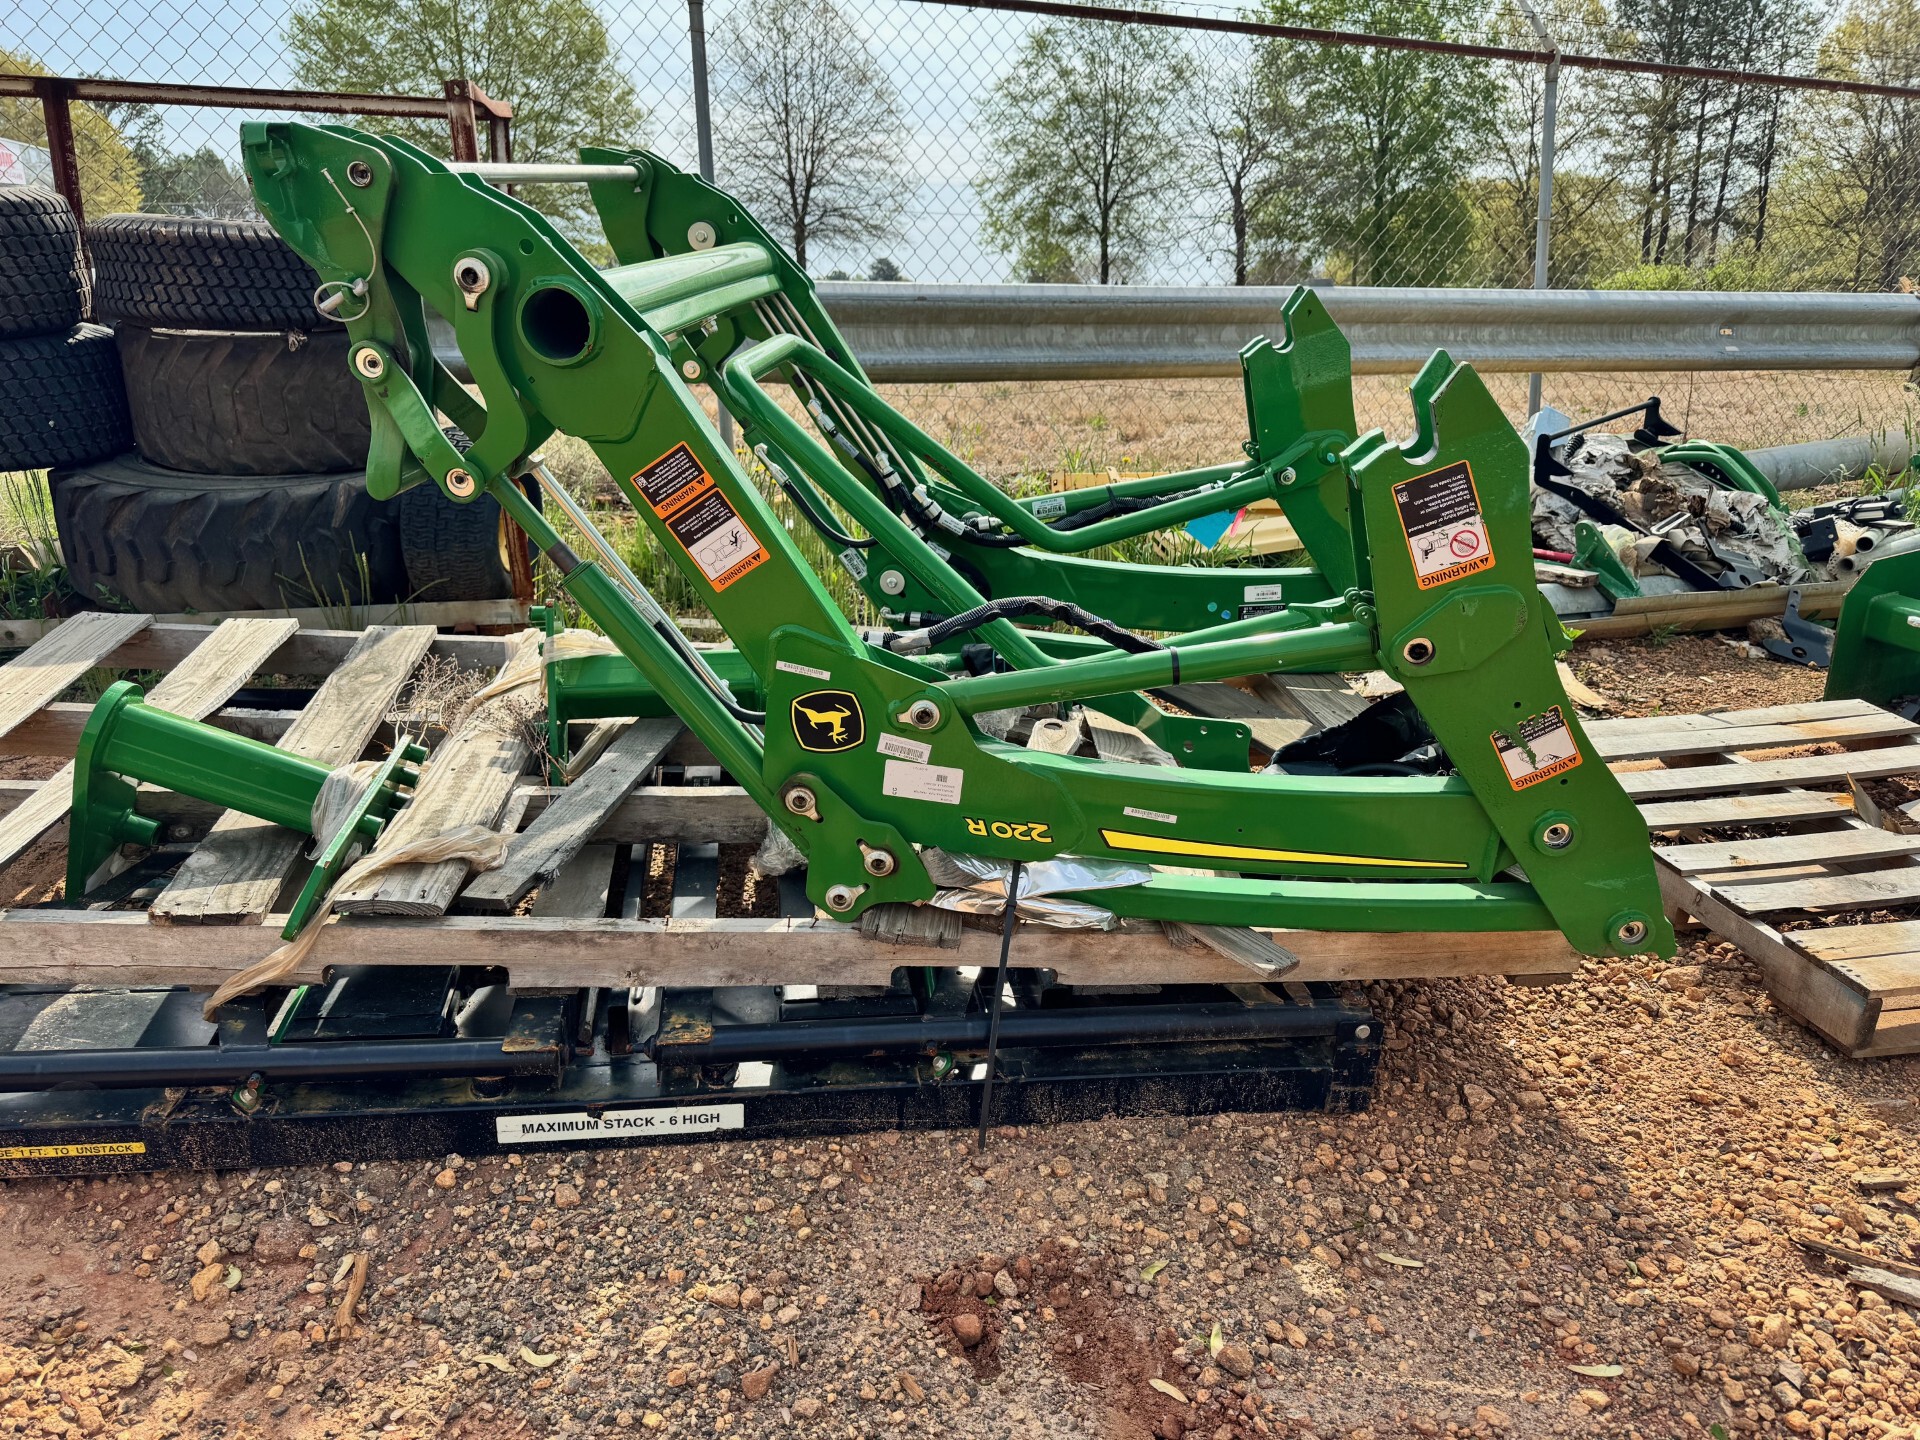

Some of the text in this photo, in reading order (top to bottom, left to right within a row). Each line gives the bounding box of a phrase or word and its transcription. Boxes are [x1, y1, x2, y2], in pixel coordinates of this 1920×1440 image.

[661, 485, 697, 512] WARNING
[718, 559, 754, 585] WARNING
[1422, 561, 1480, 587] WARNING
[1515, 761, 1570, 788] WARNING
[521, 1120, 599, 1134] MAXIMUM
[603, 1117, 655, 1129] STACK
[669, 1115, 678, 1126] 6
[682, 1113, 720, 1125] HIGH
[53, 1147, 69, 1155] TO
[76, 1144, 133, 1154] UNSTACK
